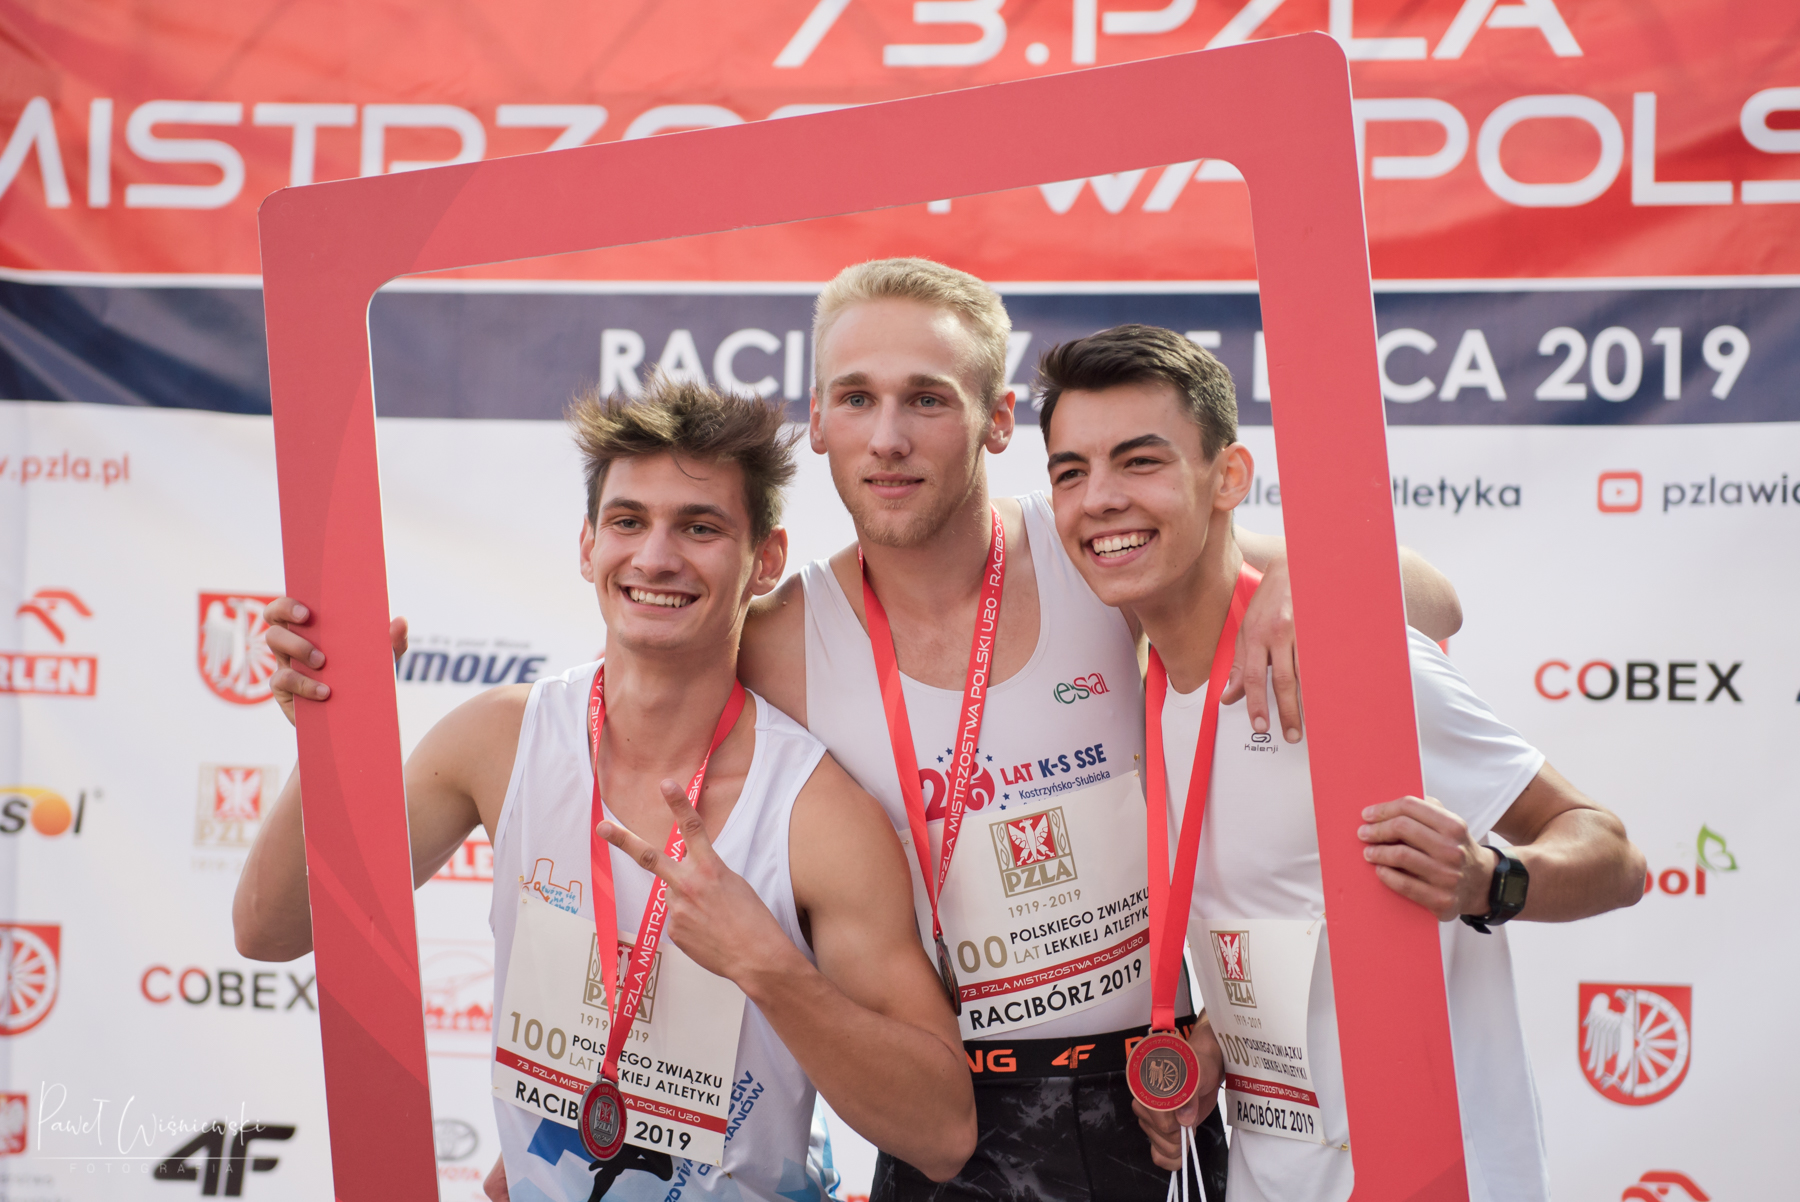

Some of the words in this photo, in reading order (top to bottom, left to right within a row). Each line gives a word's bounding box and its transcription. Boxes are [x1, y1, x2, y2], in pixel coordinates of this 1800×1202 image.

[1536, 326, 1750, 402] 2019
[1053, 672, 1110, 704] esa
[1534, 659, 1743, 703] COBEX
[948, 703, 981, 834] MISTRZOSTWA
[970, 635, 992, 699] POLSKI
[982, 597, 998, 633] U20
[1000, 762, 1034, 786] LAT
[1038, 754, 1071, 779] K-S
[1074, 743, 1107, 769] SSE
[1244, 743, 1279, 754] Kalenji
[1019, 769, 1111, 800] Kostrzyńsko-Słubicka
[1005, 864, 1073, 893] PZLA
[1008, 889, 1082, 918] 1919-2019
[957, 935, 1008, 974] 00
[1014, 945, 1040, 964] LAT
[1044, 928, 1099, 956] LEKKIEJ
[1104, 905, 1149, 938] ATLETYK
[1010, 911, 1094, 944] POLSKIEGO
[139, 964, 316, 1012] COBEX
[962, 986, 980, 998] 73.
[981, 979, 1012, 995] PZLA
[1013, 960, 1093, 988] MISTRZOSTWA
[1093, 947, 1127, 966] POLSKI
[1127, 936, 1144, 950] U20
[624, 971, 646, 1018] PZLA
[969, 980, 1095, 1031] RACIBÓRZ
[1099, 958, 1142, 996] 2019
[1225, 982, 1255, 1005] PZLA
[510, 1011, 567, 1060] 100
[569, 1052, 595, 1071] LAT
[655, 1080, 720, 1107] ATLETYKI
[572, 1034, 652, 1069] POLSEGO
[656, 1060, 723, 1089] ZWIĄZKU
[1051, 1044, 1096, 1069] 4F
[1218, 1032, 1249, 1067] 100
[1250, 1055, 1262, 1068] LAT
[1242, 1037, 1275, 1056] POLSKIEGO
[1272, 1043, 1303, 1062] ZWIĄZKU
[517, 1059, 531, 1071] 73.
[532, 1067, 558, 1083] PZLA
[636, 1100, 676, 1117] POLSKI
[678, 1112, 701, 1124] U20
[634, 1121, 692, 1151] 2019
[1237, 1101, 1287, 1130] RACIBÓRZ
[1289, 1111, 1314, 1135] 2019
[153, 1119, 297, 1197] 4F
